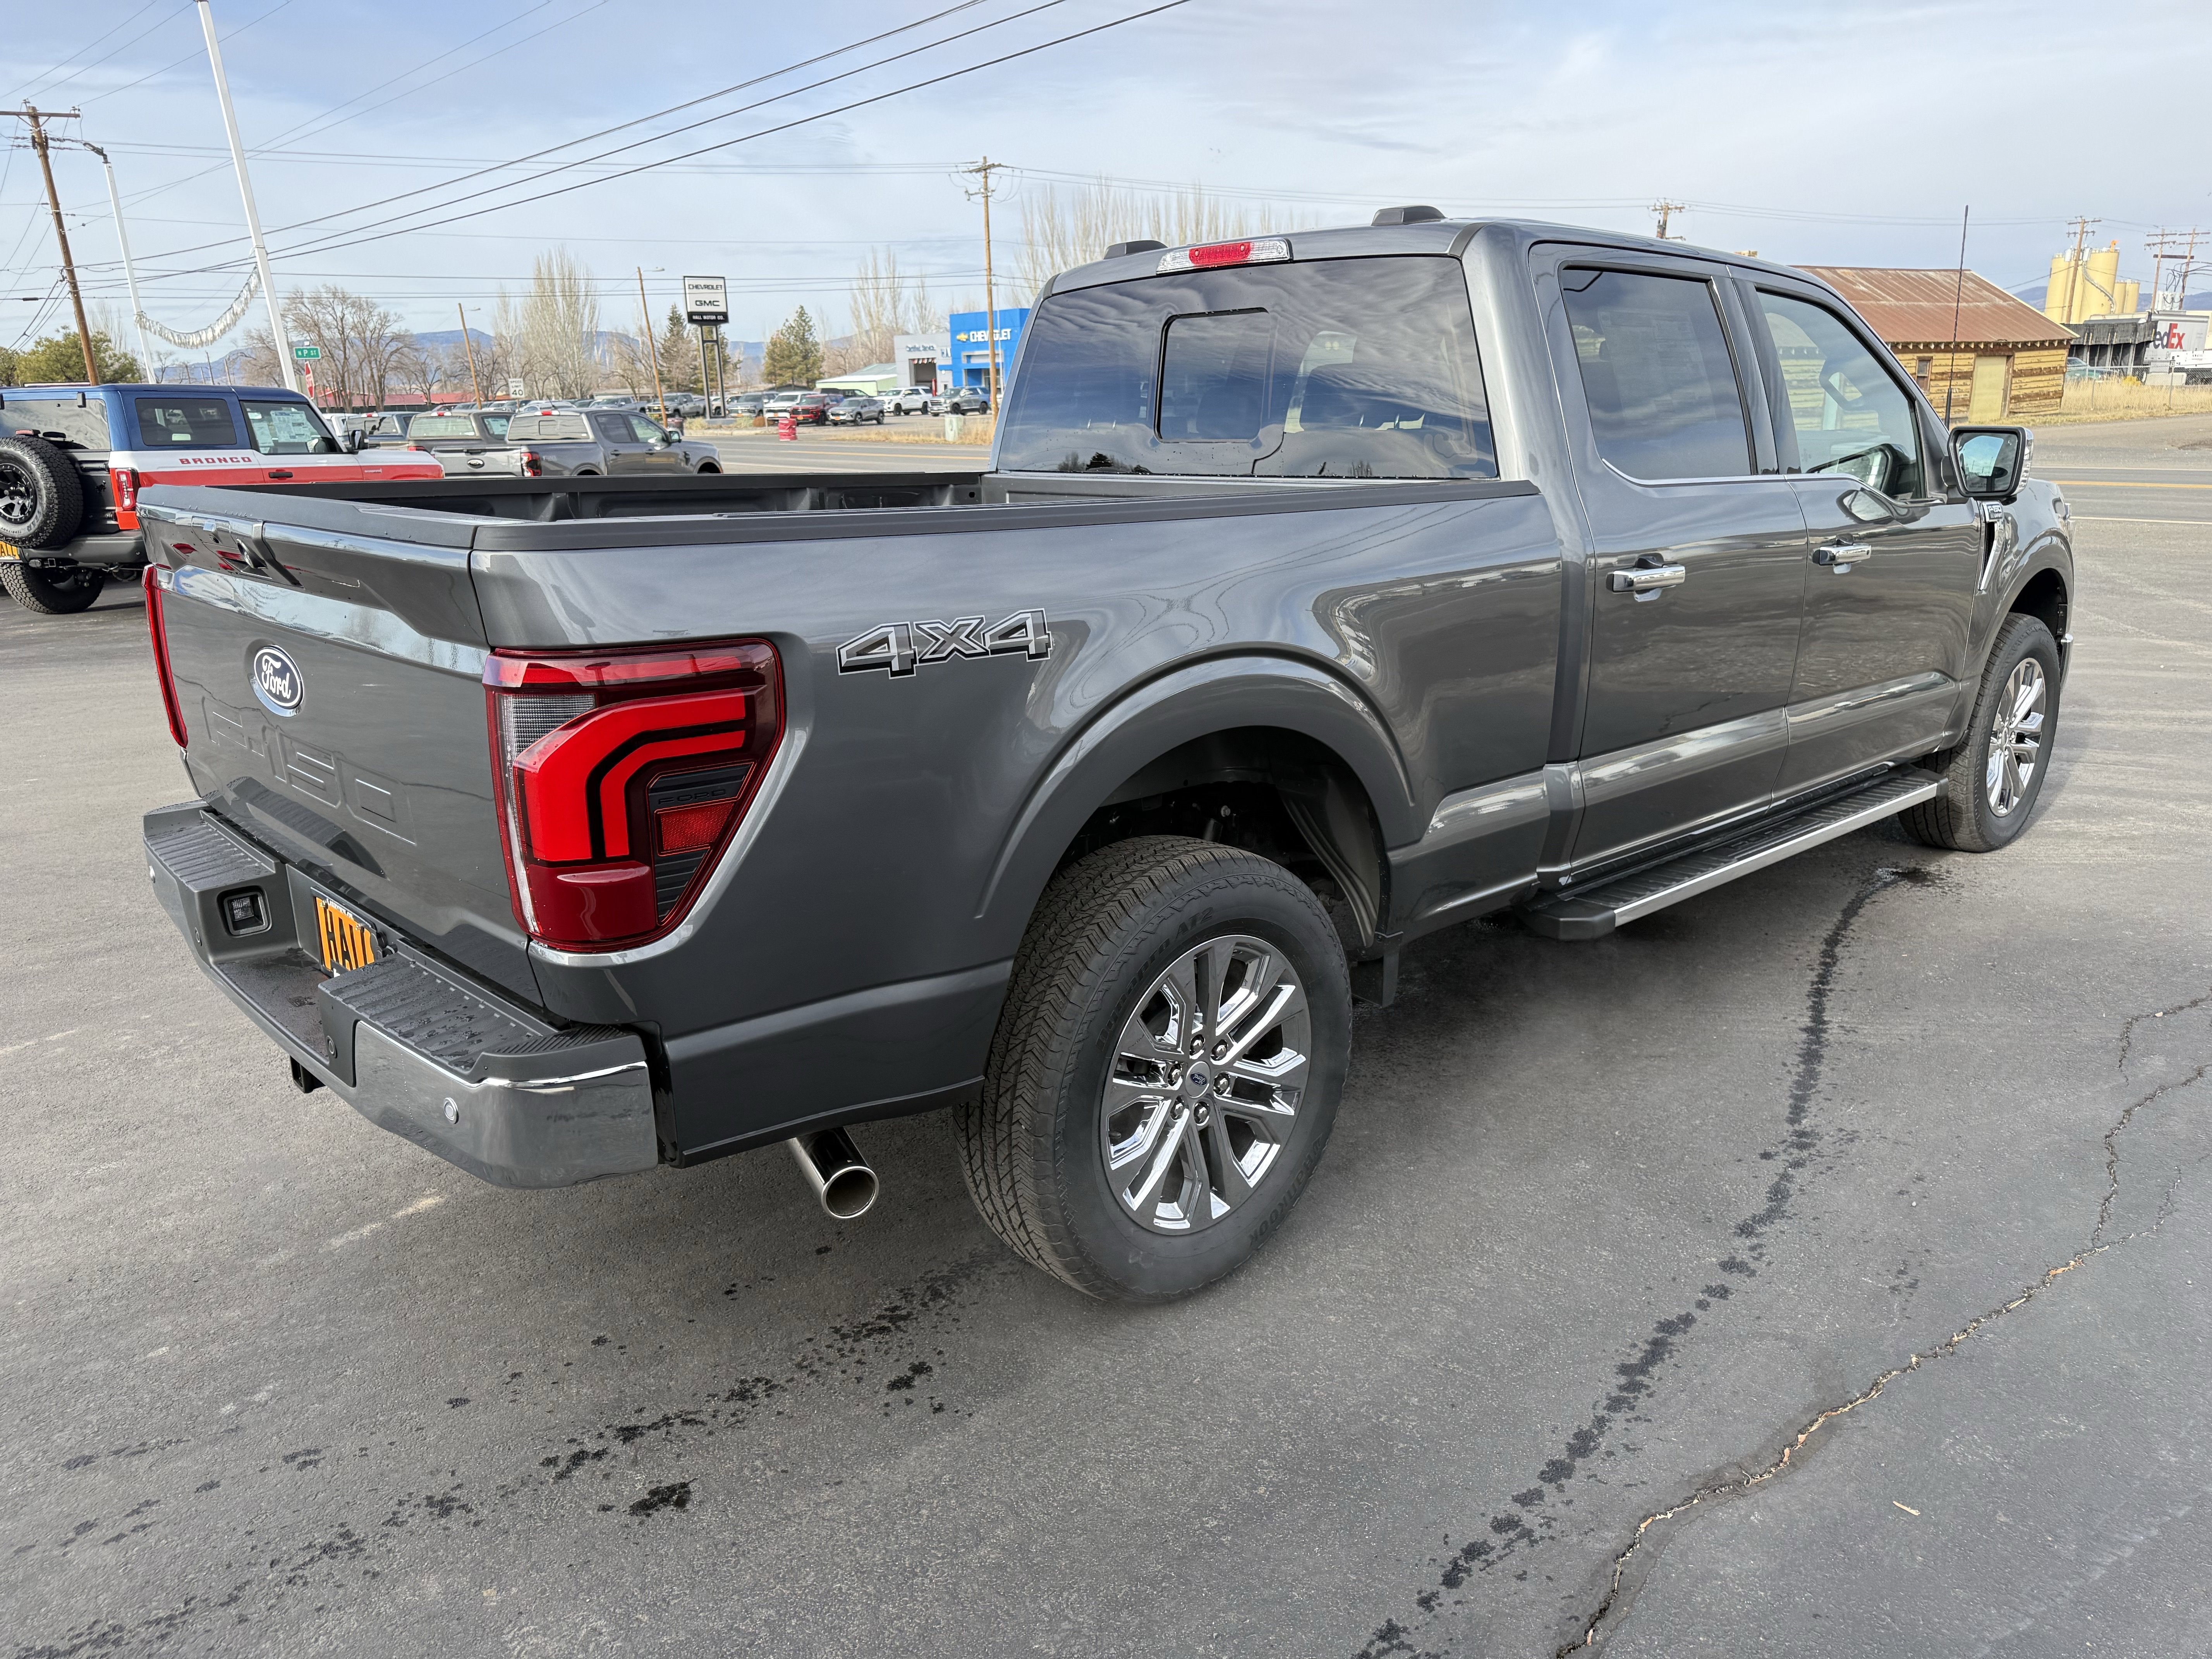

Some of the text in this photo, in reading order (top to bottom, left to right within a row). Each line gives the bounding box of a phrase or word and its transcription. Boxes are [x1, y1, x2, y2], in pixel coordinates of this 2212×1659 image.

[970, 329, 1012, 342] CHEVOLET
[2153, 323, 2186, 349] edEx
[261, 655, 291, 699] Ford
[658, 789, 726, 804] FORD
[1193, 1074, 1206, 1085] Ford
